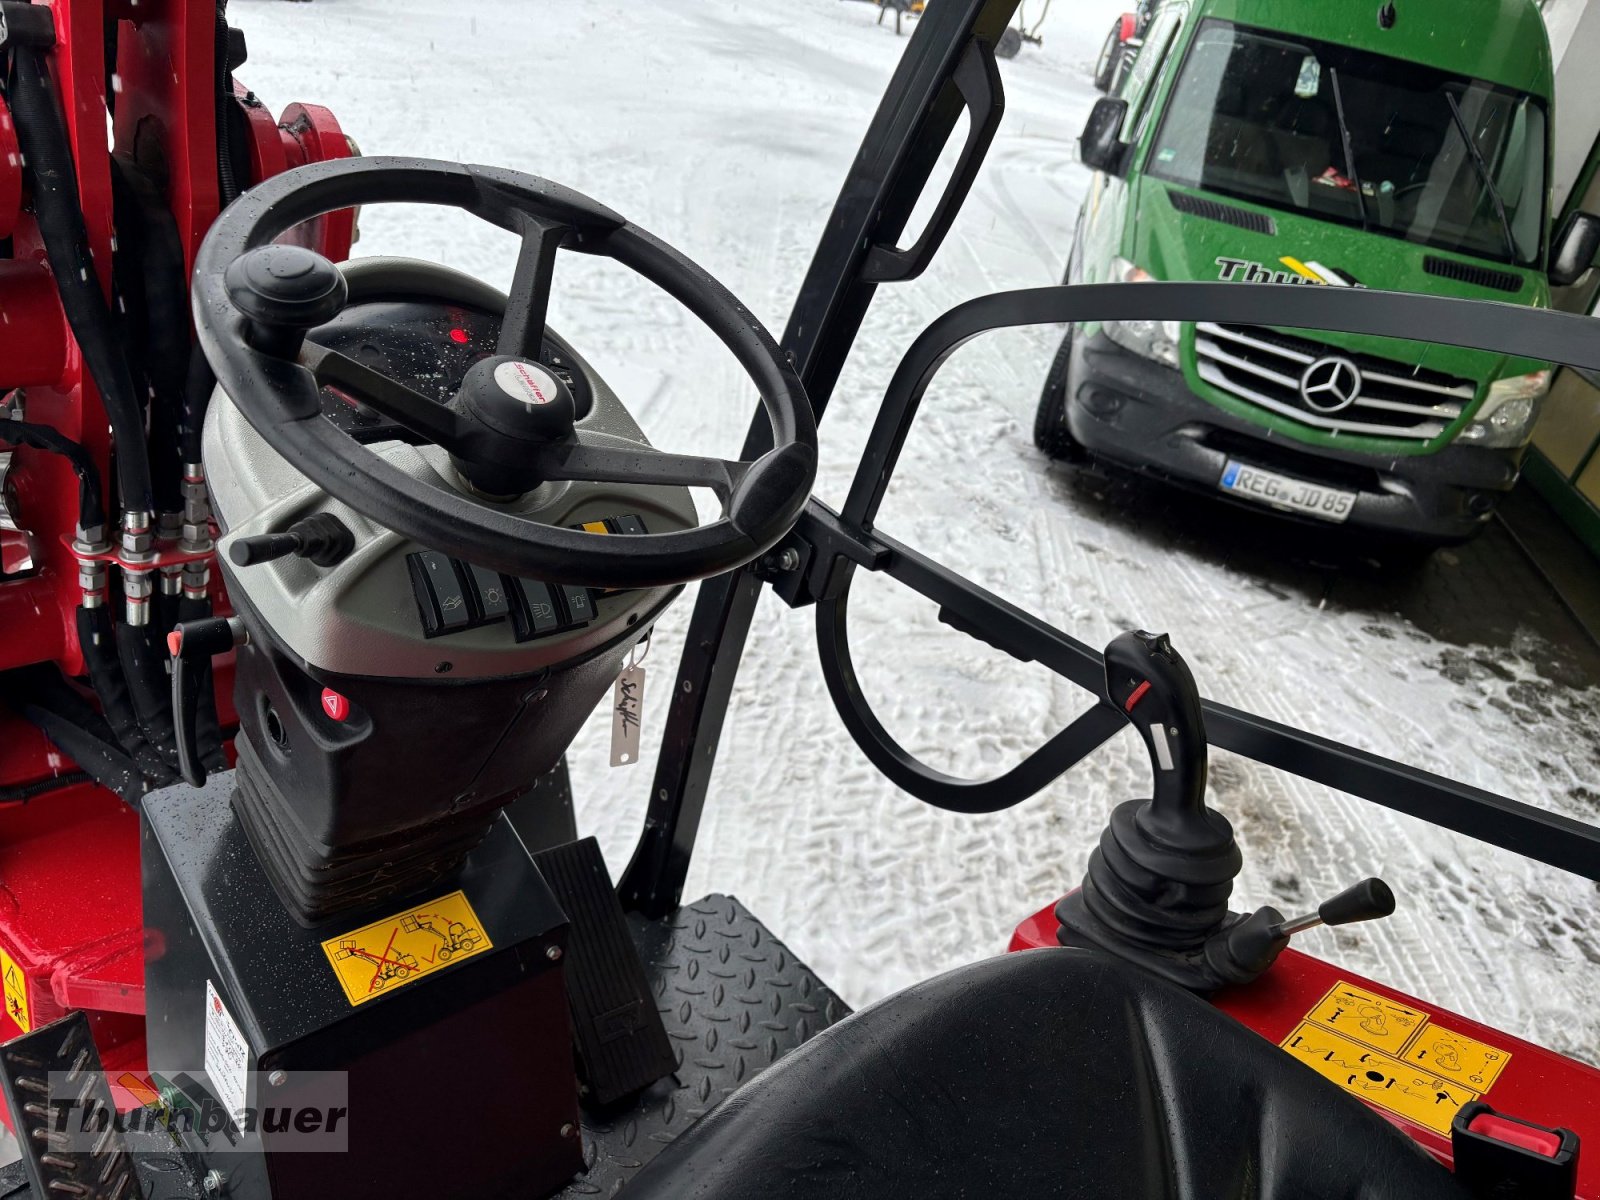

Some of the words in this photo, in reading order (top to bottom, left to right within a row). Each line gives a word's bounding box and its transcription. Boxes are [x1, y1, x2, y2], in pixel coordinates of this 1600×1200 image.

[1236, 470, 1281, 497] REG
[1292, 486, 1322, 508] JD
[1322, 493, 1352, 514] 85
